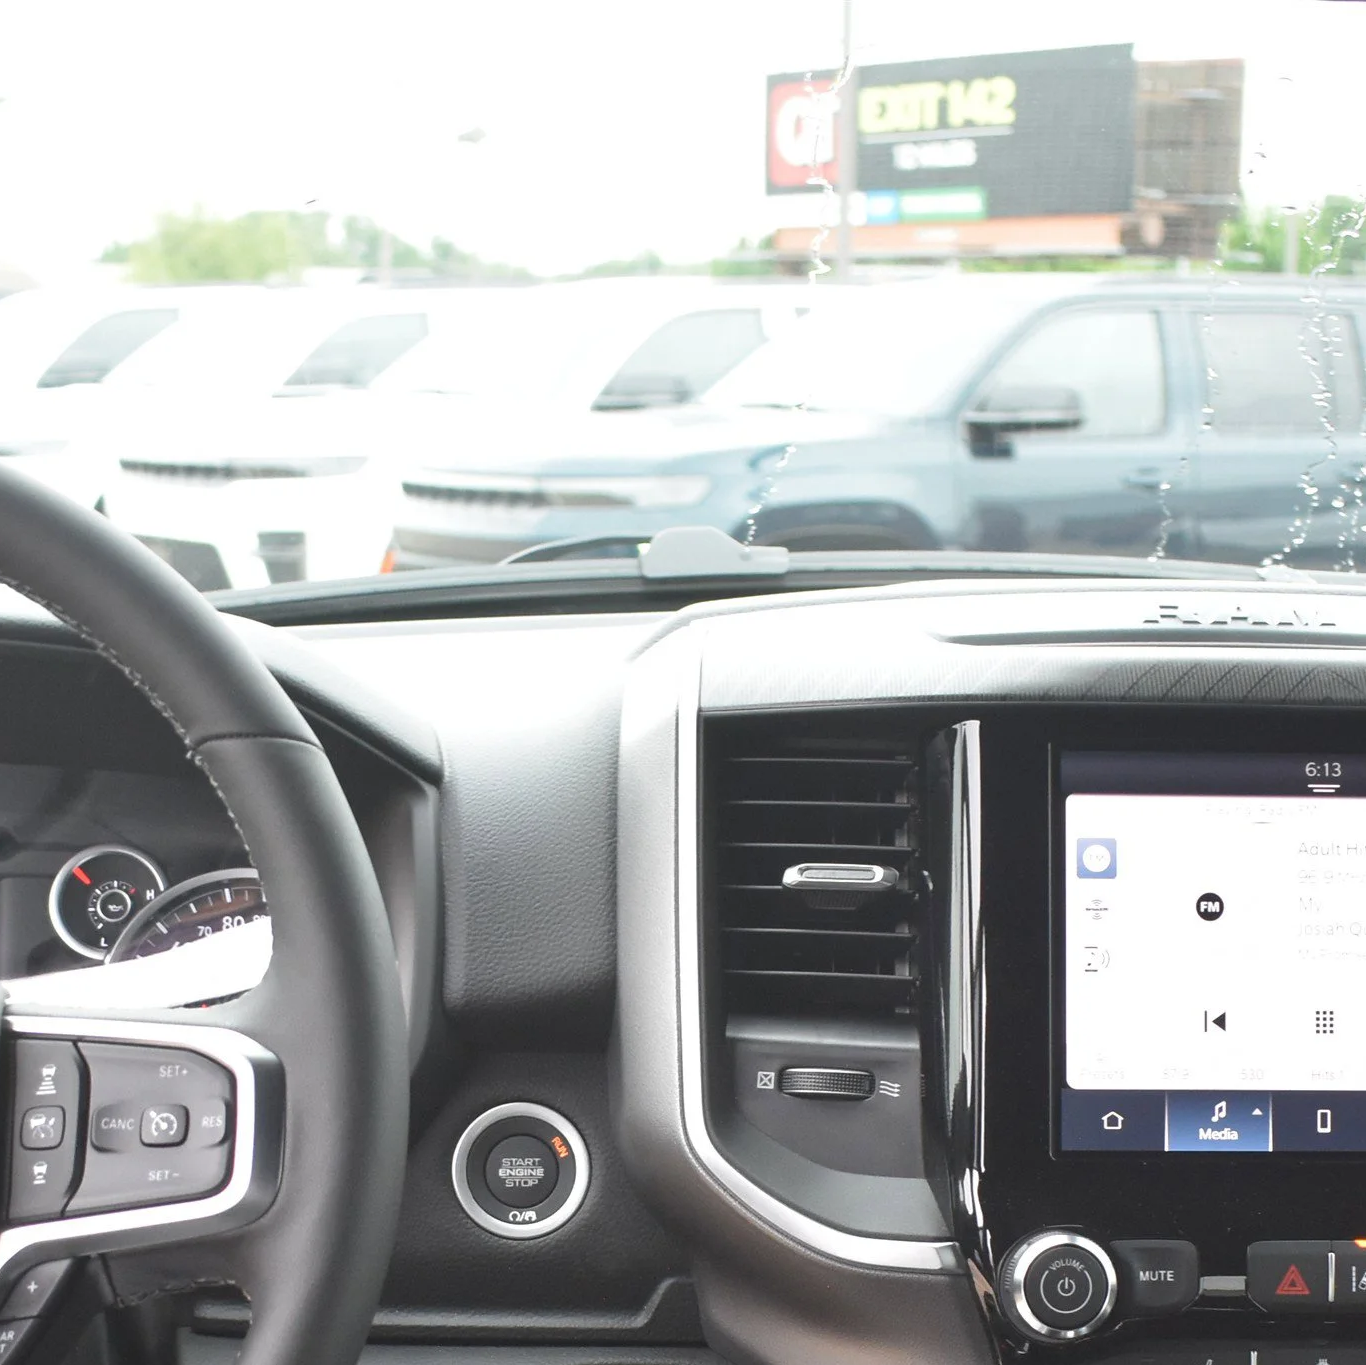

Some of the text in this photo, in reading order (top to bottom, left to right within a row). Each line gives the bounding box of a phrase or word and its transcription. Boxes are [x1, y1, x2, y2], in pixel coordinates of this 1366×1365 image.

[857, 76, 1016, 134] EXIT 142
[1305, 762, 1342, 777] 6:13
[1296, 842, 1341, 856] Adult
[146, 889, 155, 901] H
[1200, 901, 1220, 913] FM
[222, 916, 245, 933] 80
[101, 938, 109, 948] L
[101, 1117, 135, 1131] CANC
[202, 1116, 223, 1128] RES
[1198, 1128, 1239, 1141] Media
[552, 1136, 569, 1158] RUN
[502, 1158, 541, 1167] START
[499, 1168, 545, 1177] ENGINE
[506, 1179, 539, 1188] STOP
[1049, 1258, 1085, 1273] VOLUME
[1140, 1270, 1175, 1282] MUTE
